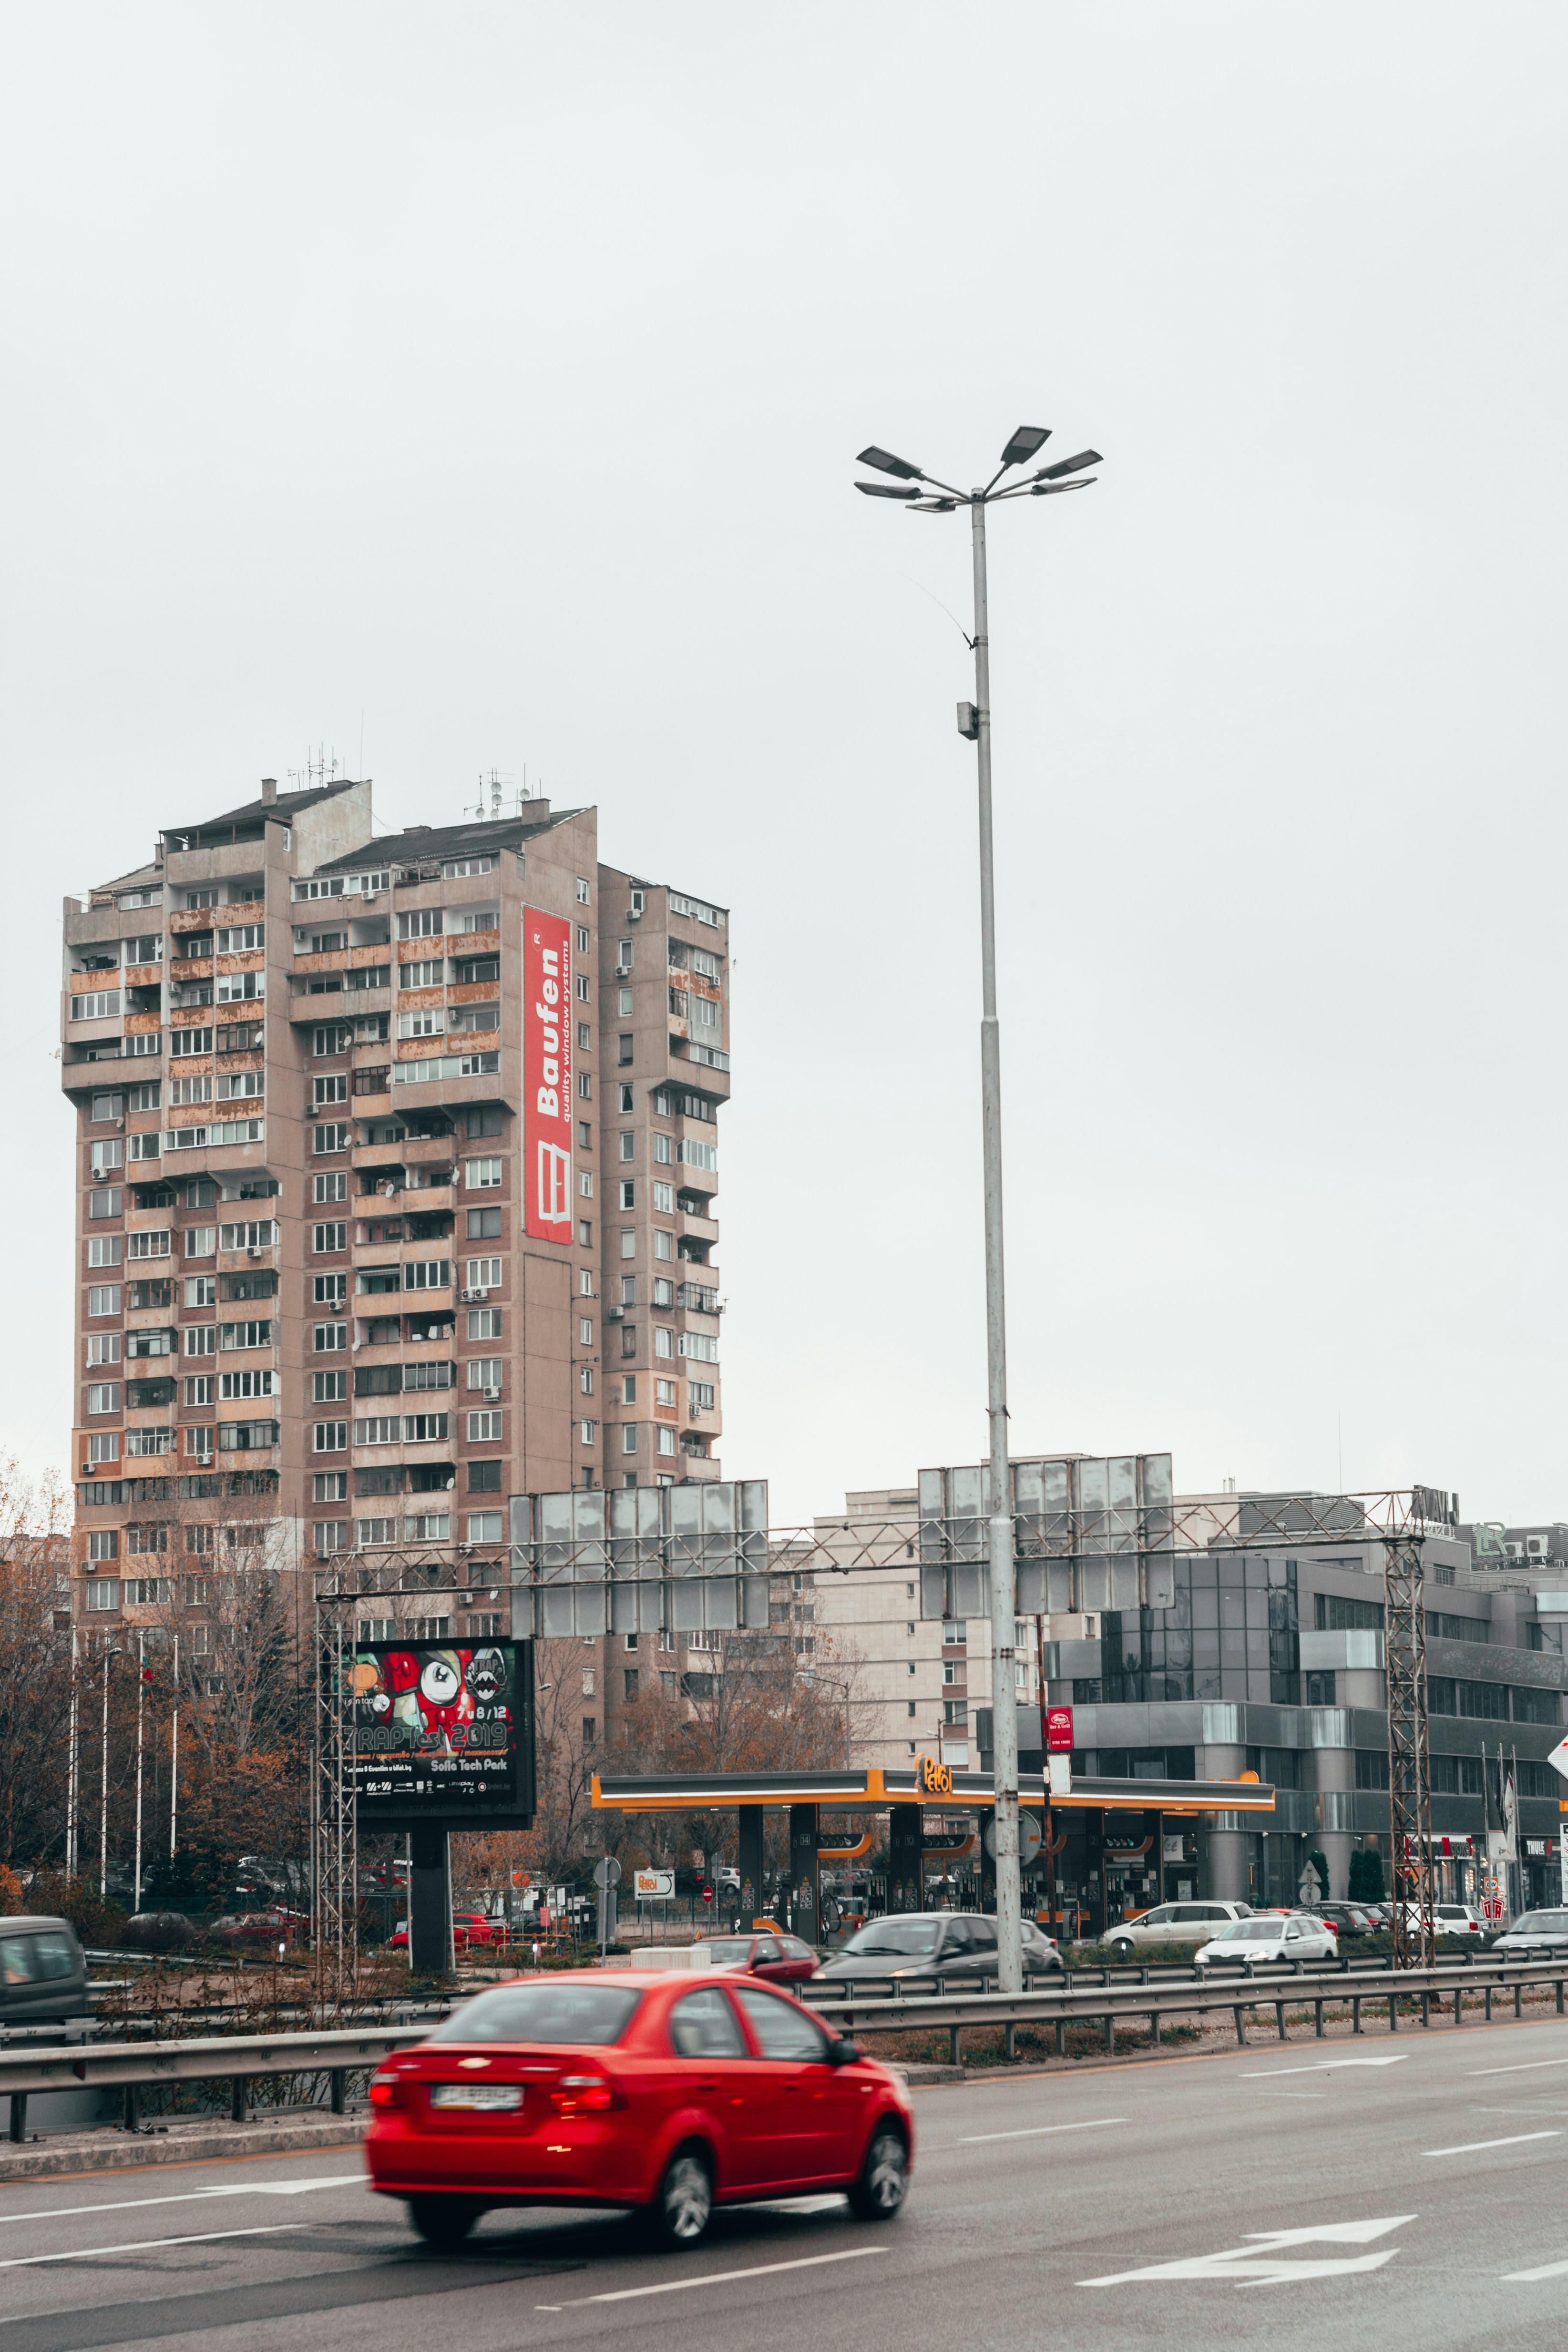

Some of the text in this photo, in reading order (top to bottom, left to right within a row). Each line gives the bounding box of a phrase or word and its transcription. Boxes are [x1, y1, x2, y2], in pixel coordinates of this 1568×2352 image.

[536, 948, 559, 1118] Baufen
[562, 1069, 572, 1123] quality
[473, 1659, 498, 1671] TRAP
[493, 1706, 507, 1718] 12
[344, 1722, 507, 1751] TRAP fest 2019
[431, 1758, 507, 1772] Sofia Tech Park
[924, 1756, 952, 1792] Petrol
[801, 1836, 809, 1844] 14
[906, 1836, 913, 1844] 10
[1527, 1841, 1545, 1855] THULE
